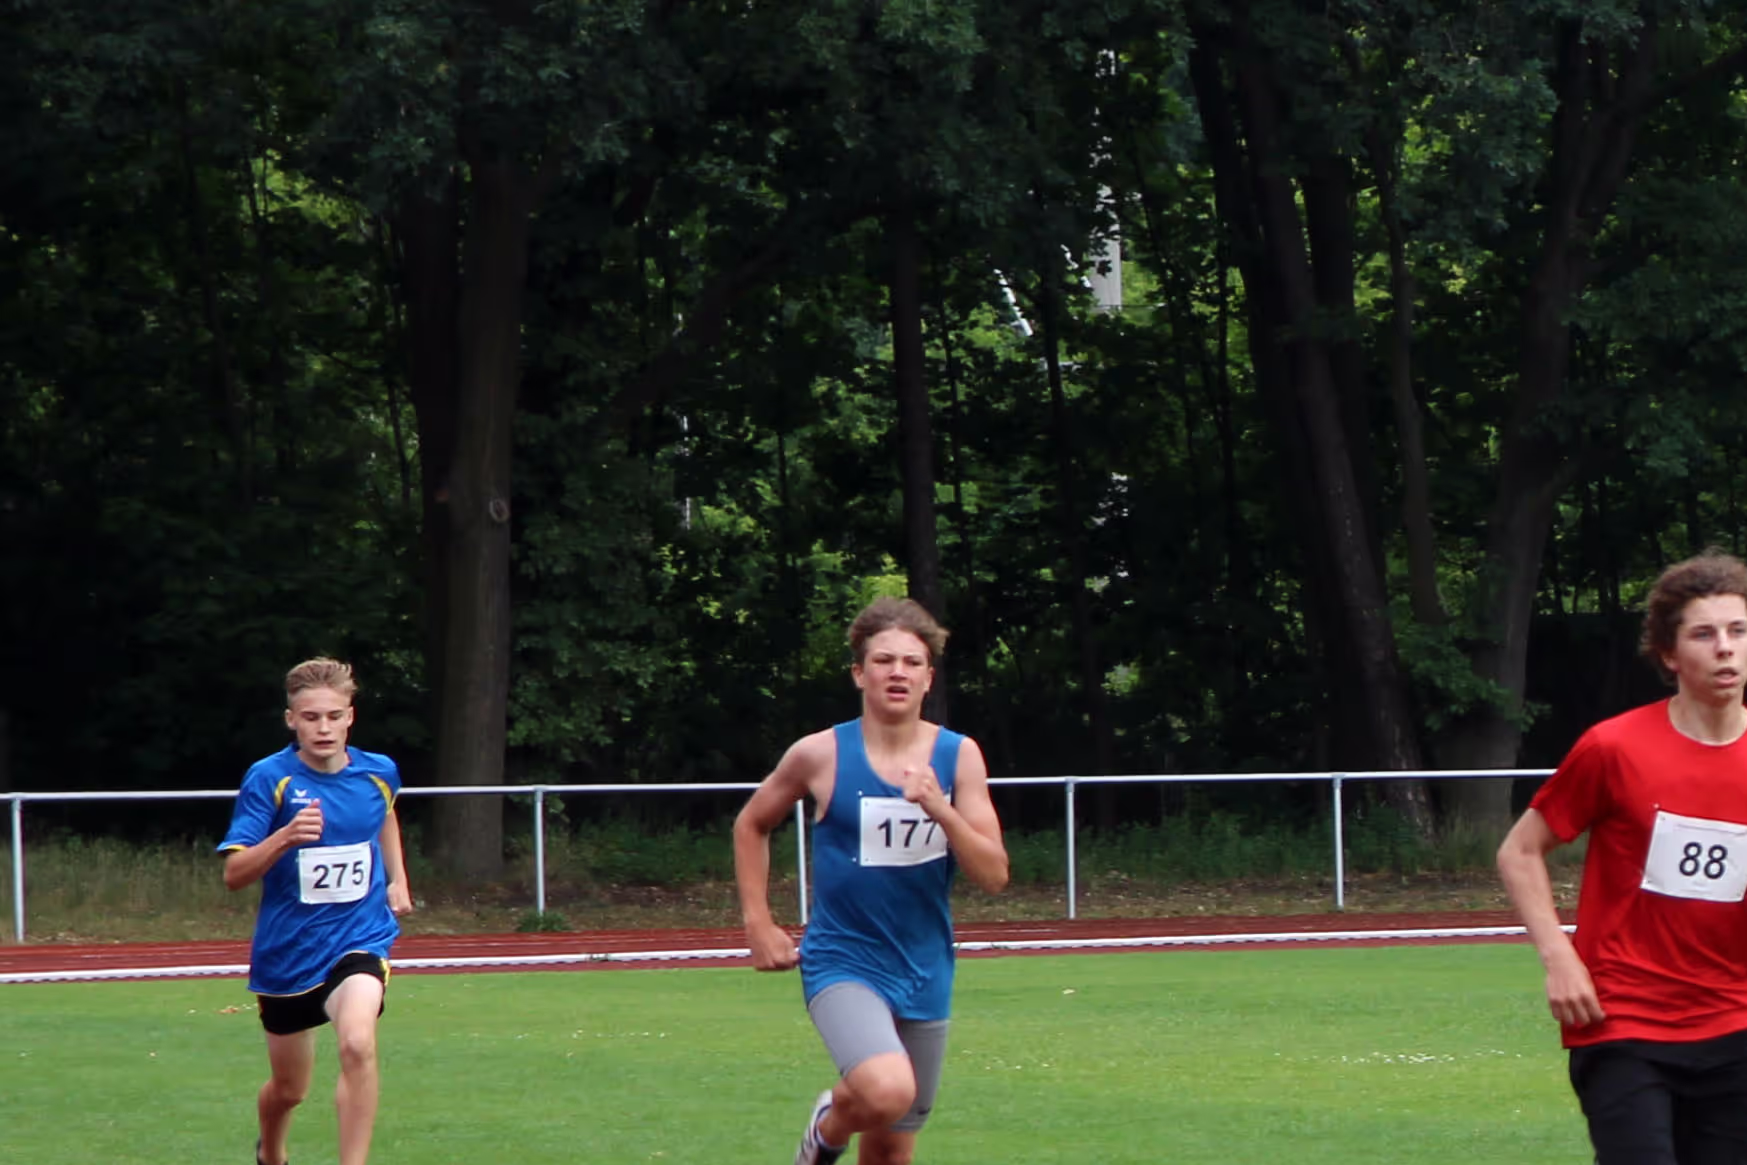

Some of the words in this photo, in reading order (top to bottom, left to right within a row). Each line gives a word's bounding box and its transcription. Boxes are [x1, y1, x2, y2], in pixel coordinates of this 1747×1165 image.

[877, 818, 938, 848] 177
[312, 860, 365, 890] 275
[1678, 841, 1728, 880] 88
